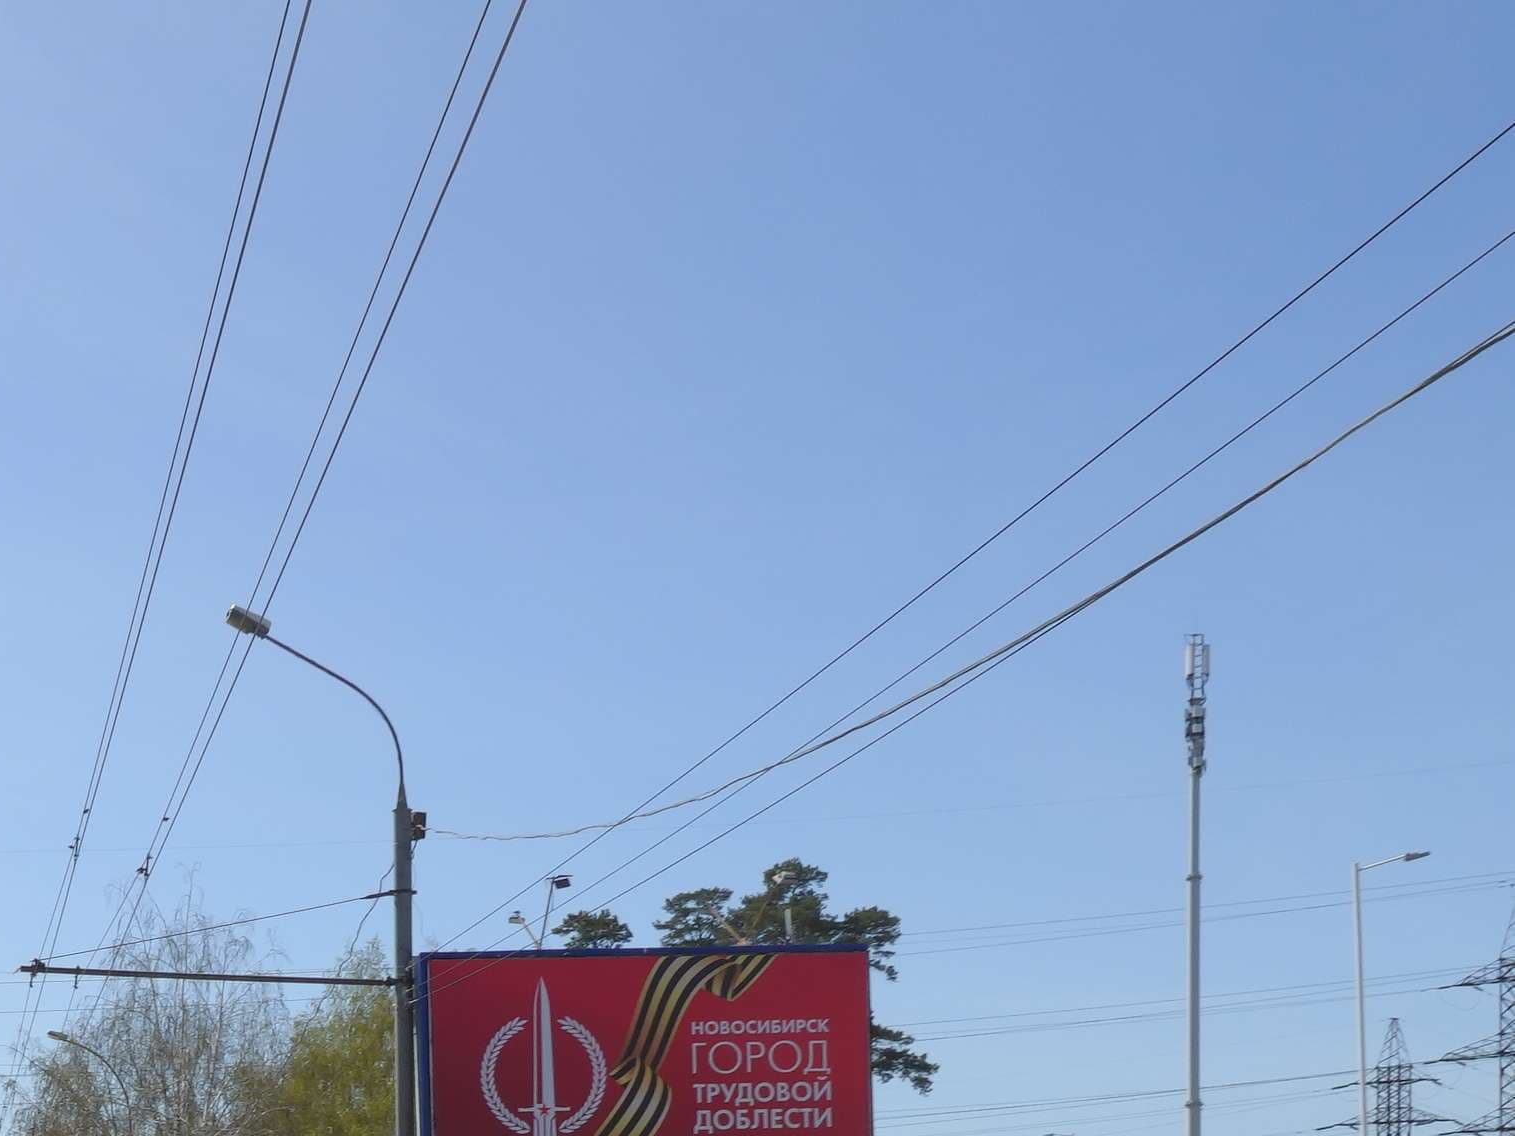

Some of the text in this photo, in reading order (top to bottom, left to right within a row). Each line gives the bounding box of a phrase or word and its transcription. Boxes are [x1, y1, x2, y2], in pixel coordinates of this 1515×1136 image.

[691, 1018, 830, 1035] НОВОСИБИРСК
[692, 1039, 831, 1075] ГОРОД
[692, 1075, 832, 1106] ТРУДОВОЙ
[693, 1106, 834, 1134] ДОБЛЕСТИ
